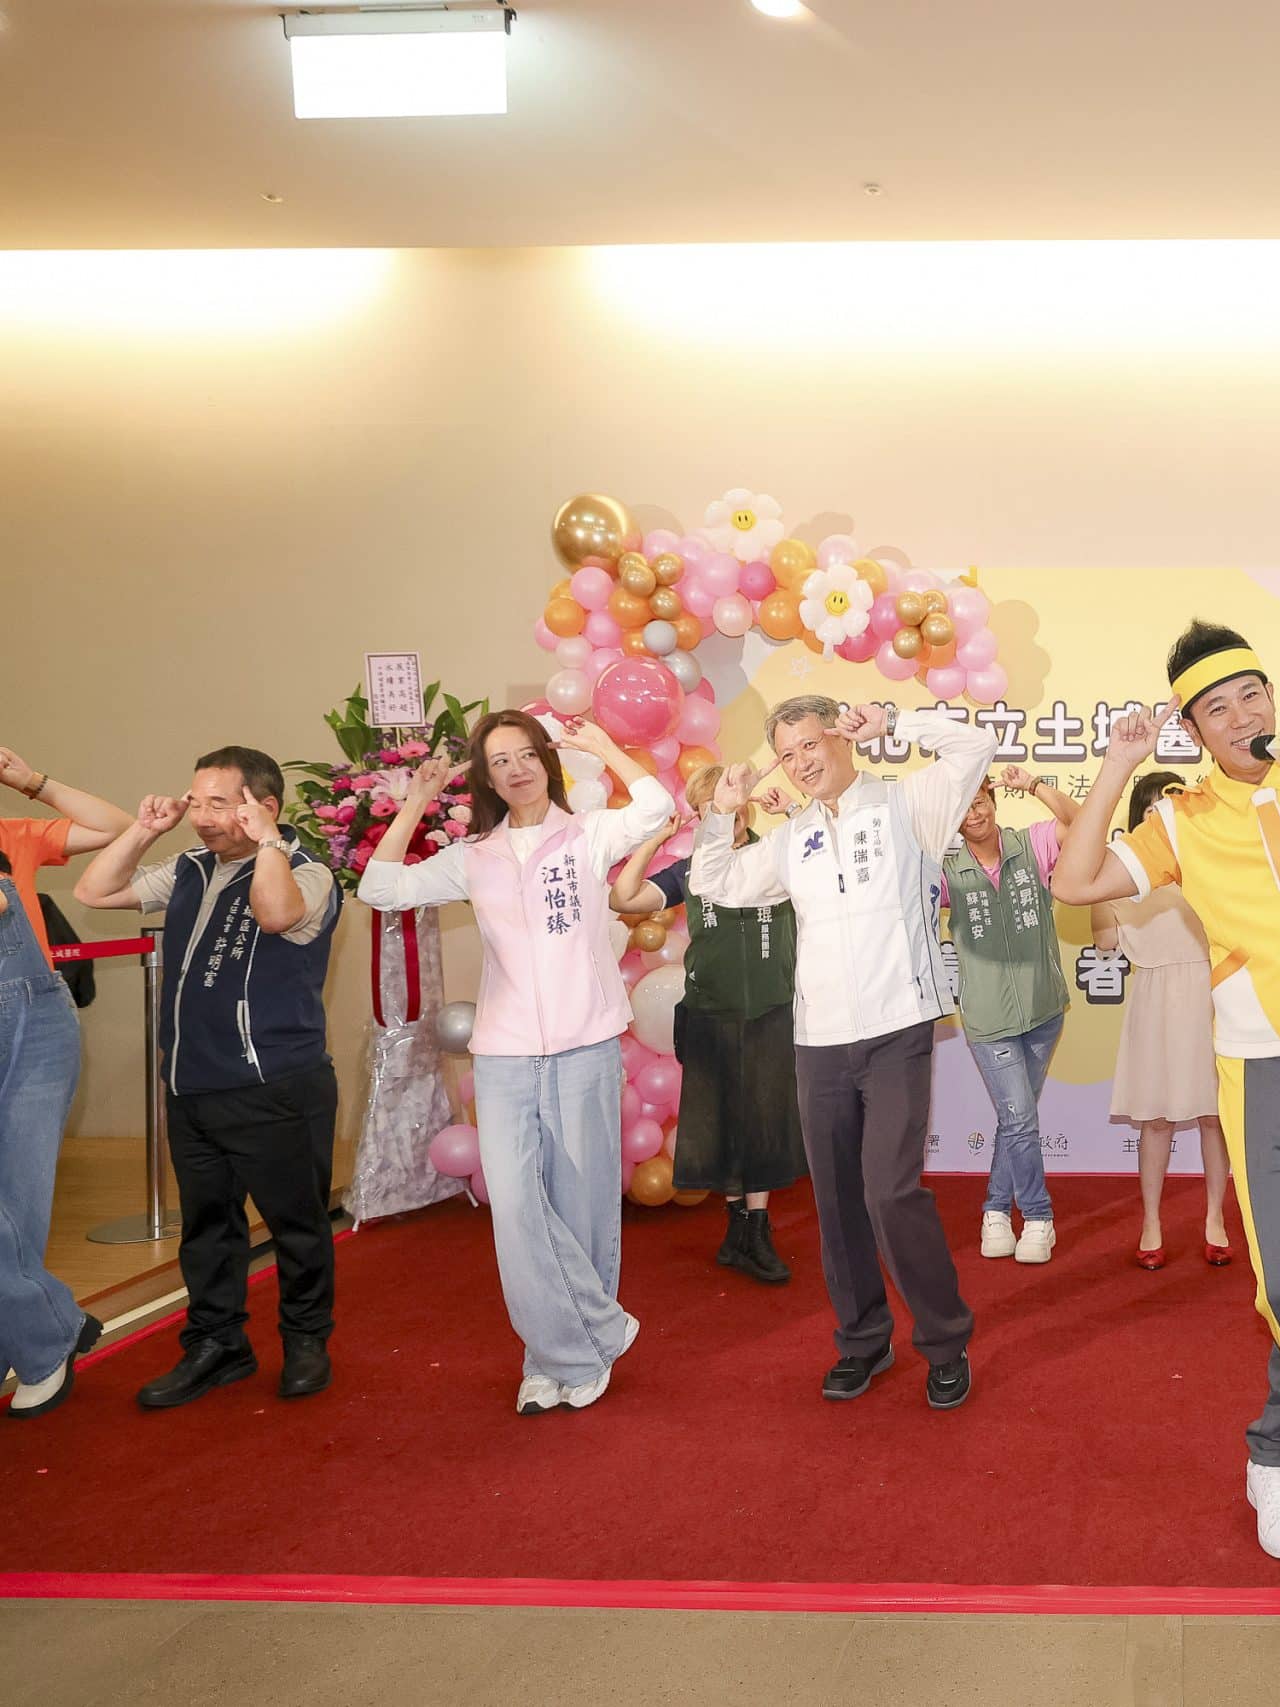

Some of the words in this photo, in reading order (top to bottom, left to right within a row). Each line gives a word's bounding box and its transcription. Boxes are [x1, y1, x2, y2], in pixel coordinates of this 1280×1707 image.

[541, 866, 572, 936] 江怡臻
[563, 853, 582, 922] 新北市議員
